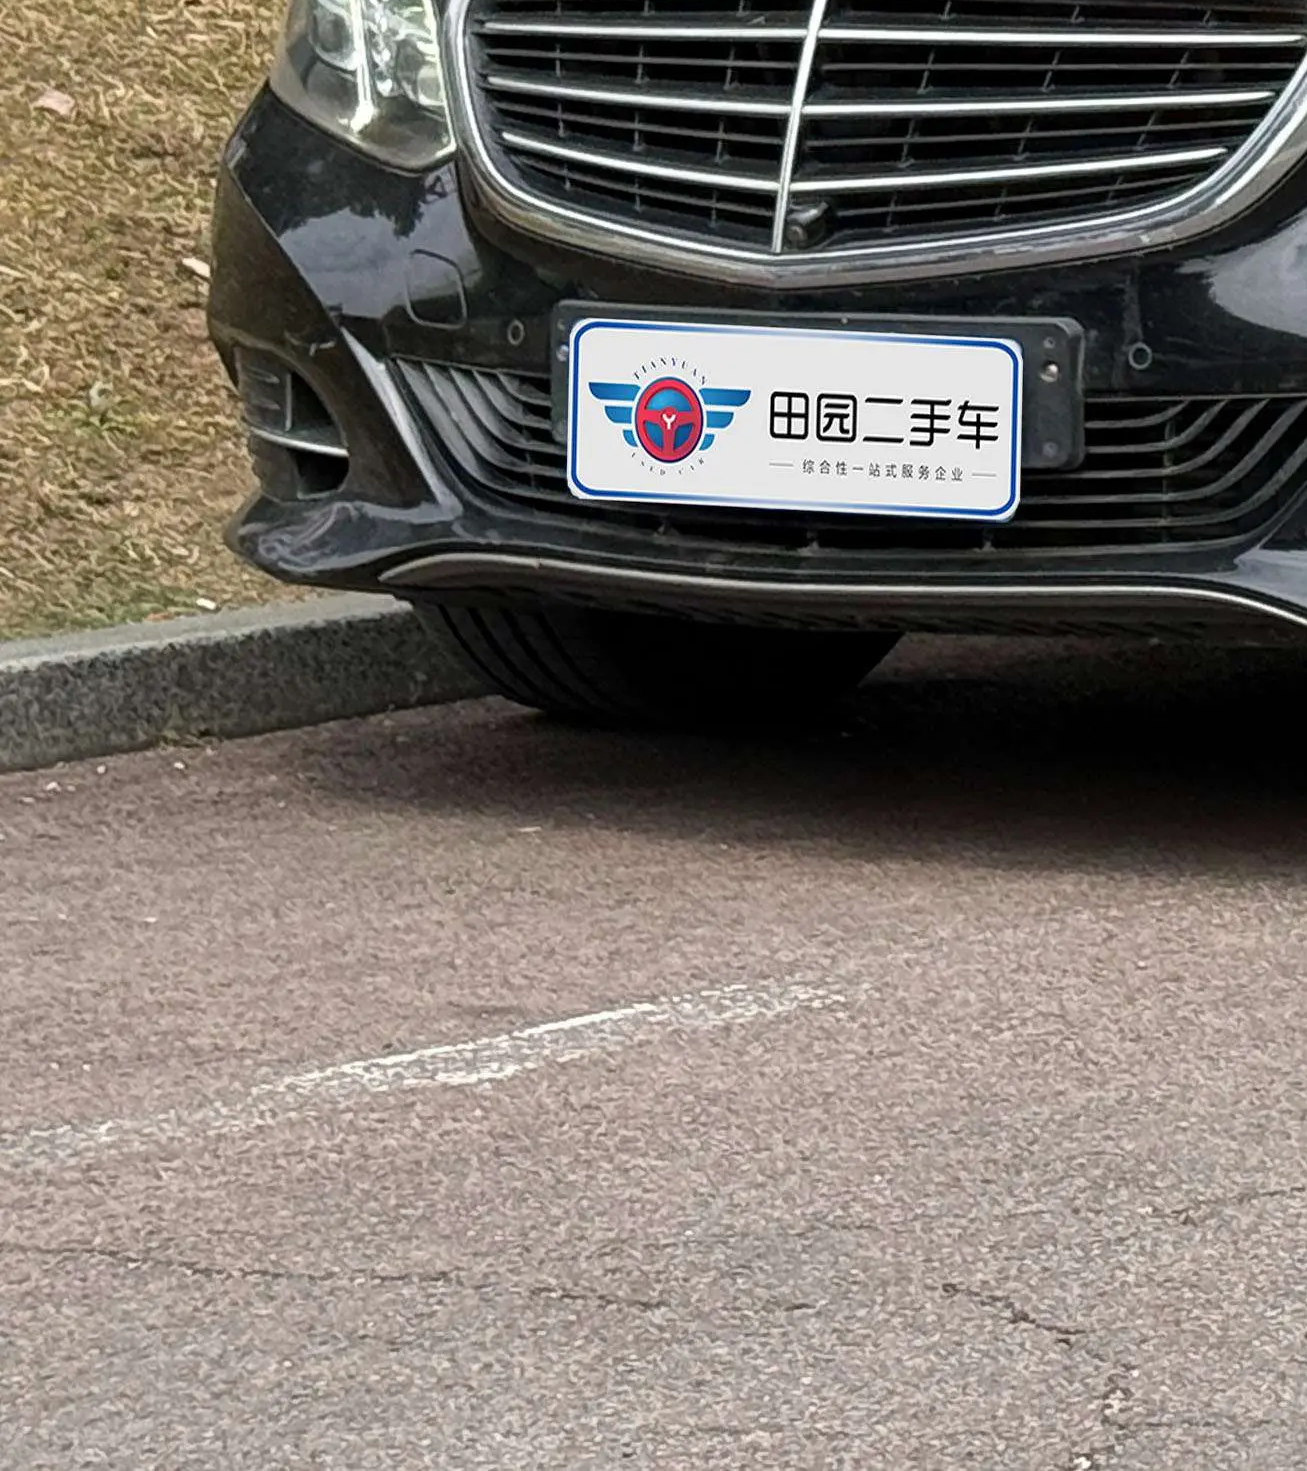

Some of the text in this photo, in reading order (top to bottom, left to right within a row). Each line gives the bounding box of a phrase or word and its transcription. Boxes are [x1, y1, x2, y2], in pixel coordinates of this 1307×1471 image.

[769, 391, 1000, 450] 田园二手车
[801, 459, 964, 481] 综合性一站式服务企业
